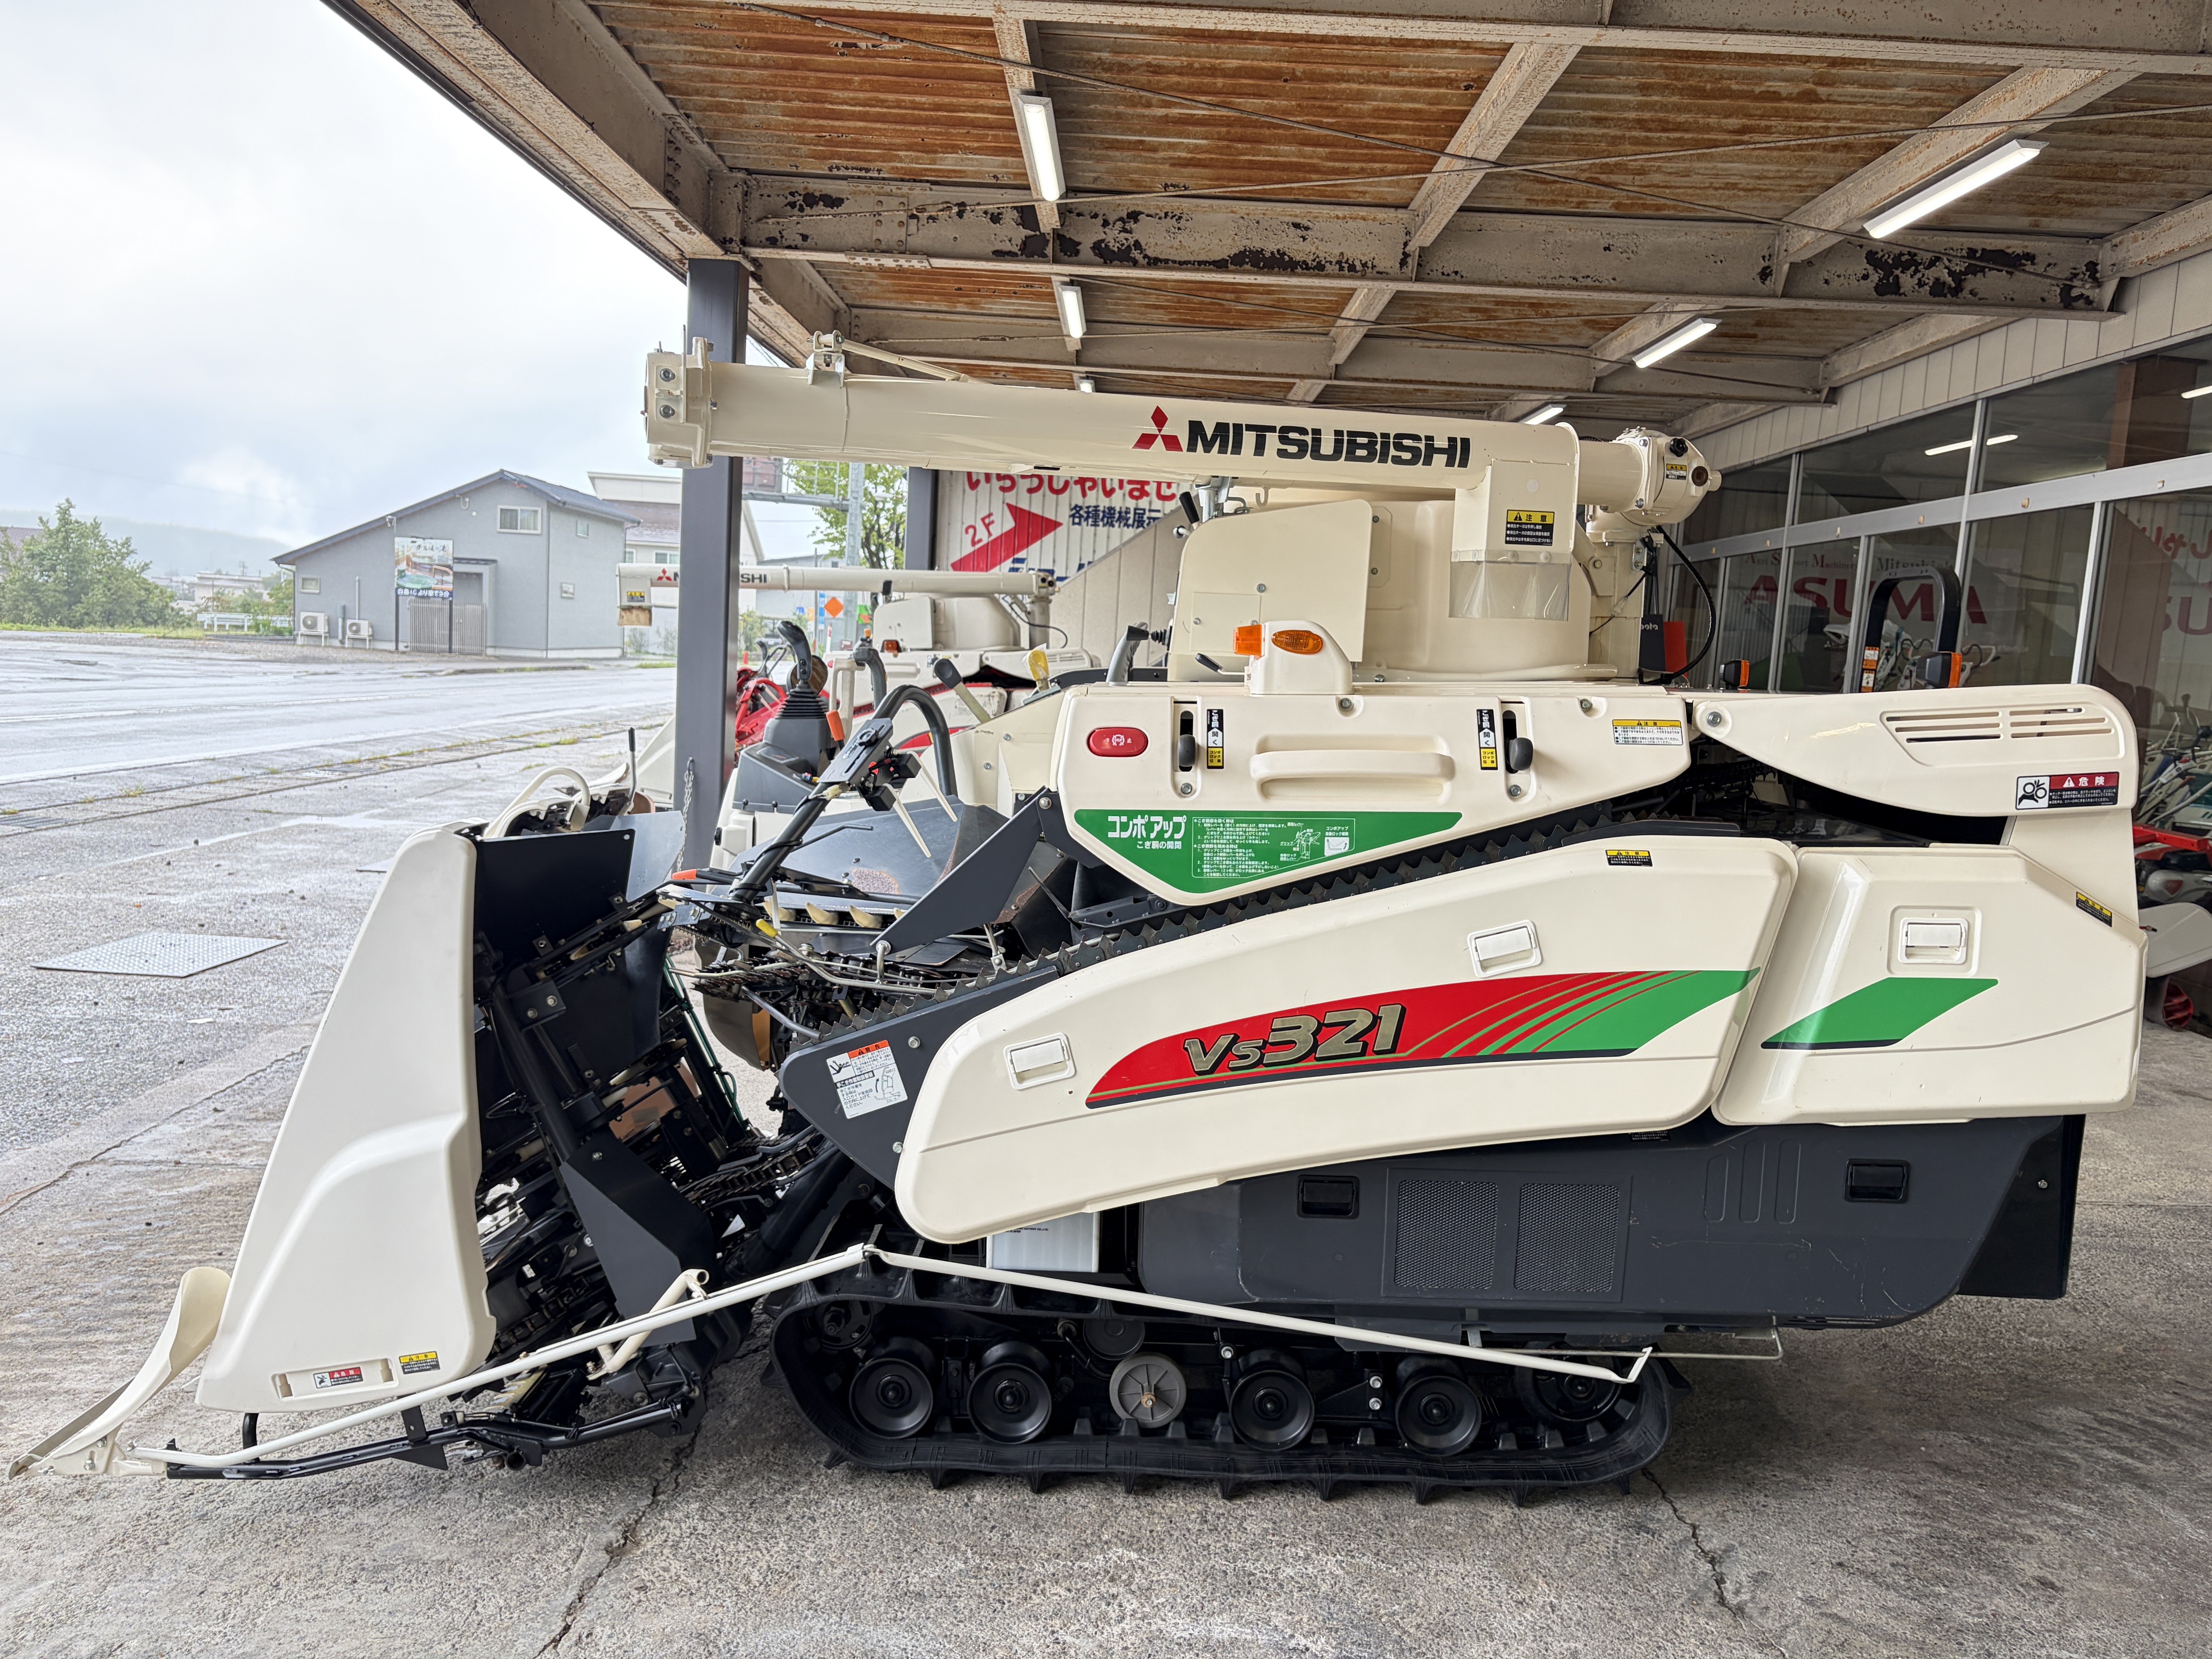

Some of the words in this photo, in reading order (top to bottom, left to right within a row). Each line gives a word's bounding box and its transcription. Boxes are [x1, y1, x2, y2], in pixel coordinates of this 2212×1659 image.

[1187, 420, 1470, 469] MITSUBISHI
[965, 512, 996, 547] 2F
[2079, 776, 2105, 787] 危険
[1108, 814, 1187, 839] コンポアップ
[1137, 841, 1182, 849] こぎ胴の開閉
[1184, 1003, 1407, 1075] Vs321
